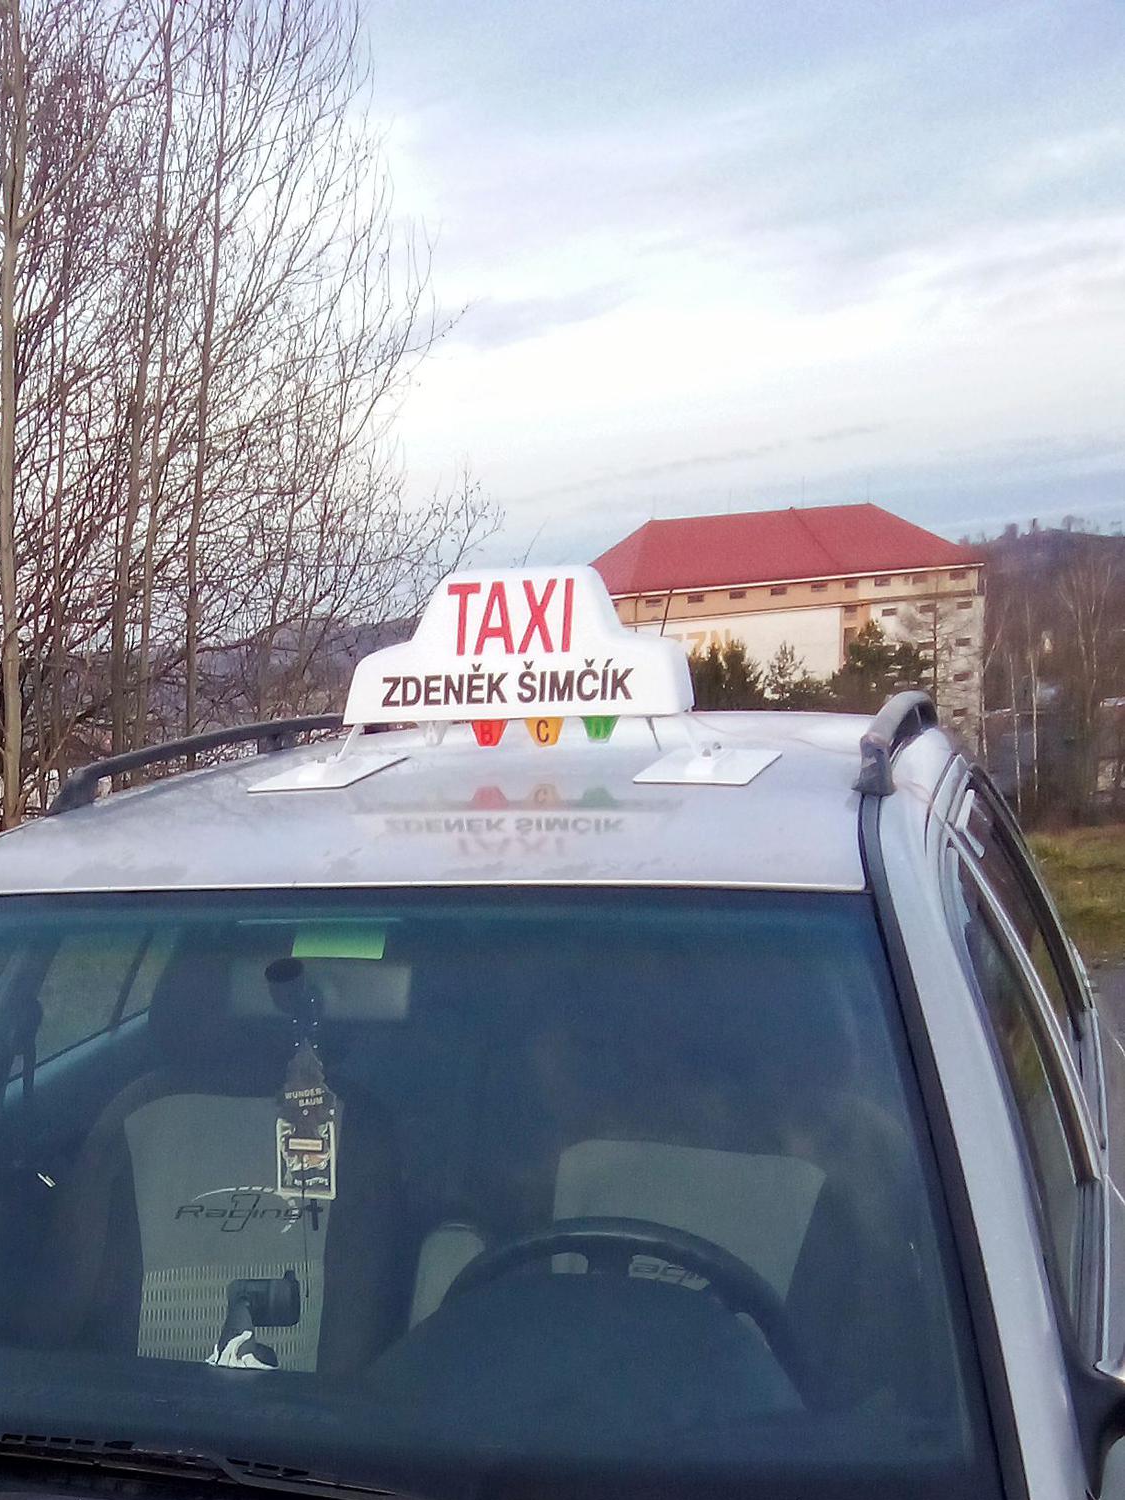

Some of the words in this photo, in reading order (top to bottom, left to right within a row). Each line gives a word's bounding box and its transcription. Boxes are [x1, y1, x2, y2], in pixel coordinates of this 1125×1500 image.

[447, 578, 575, 656] TAXI
[381, 663, 508, 708] ZDENĚK
[517, 658, 635, 703] ŠIMČÍK
[479, 722, 494, 744] B
[535, 719, 550, 743] C
[298, 1097, 324, 1107] BAUM
